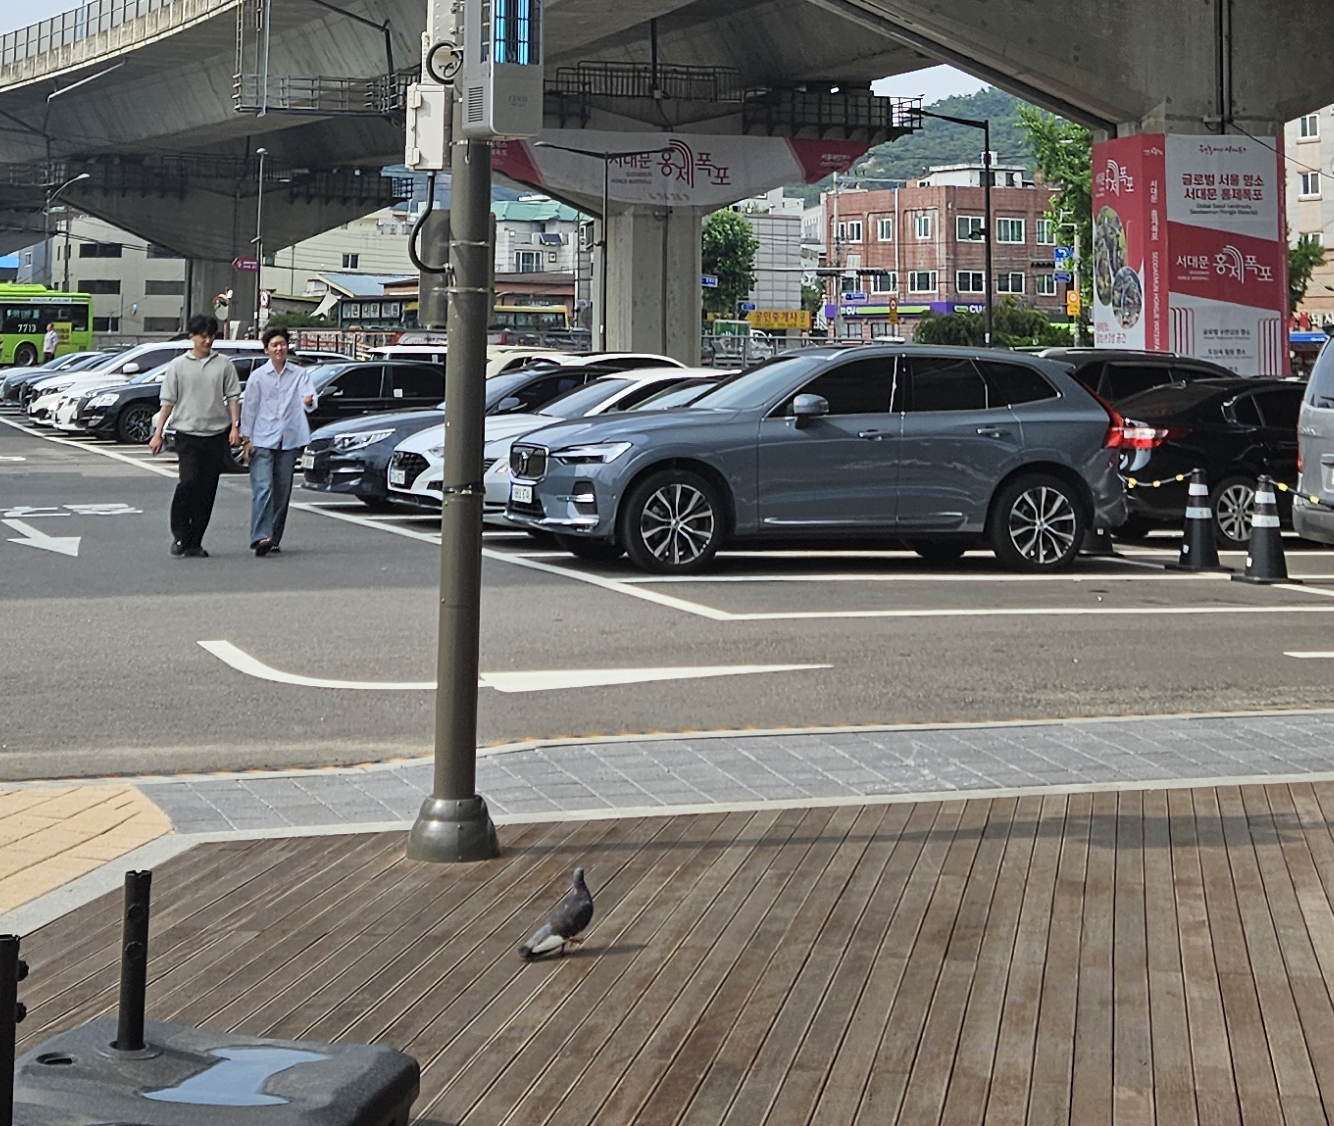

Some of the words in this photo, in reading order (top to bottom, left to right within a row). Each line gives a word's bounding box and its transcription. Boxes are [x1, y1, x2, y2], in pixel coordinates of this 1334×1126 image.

[1182, 173, 1215, 186] 글로벌
[1218, 173, 1239, 186] 서울
[1243, 174, 1264, 187] 명소
[1184, 188, 1217, 200] 서대문
[1221, 188, 1263, 201] 홍제폭포
[1176, 255, 1209, 270] 서대문
[845, 306, 856, 315] CU
[969, 304, 986, 314] CU
[754, 311, 797, 323] 공인중개사
[17, 323, 37, 333] 7713
